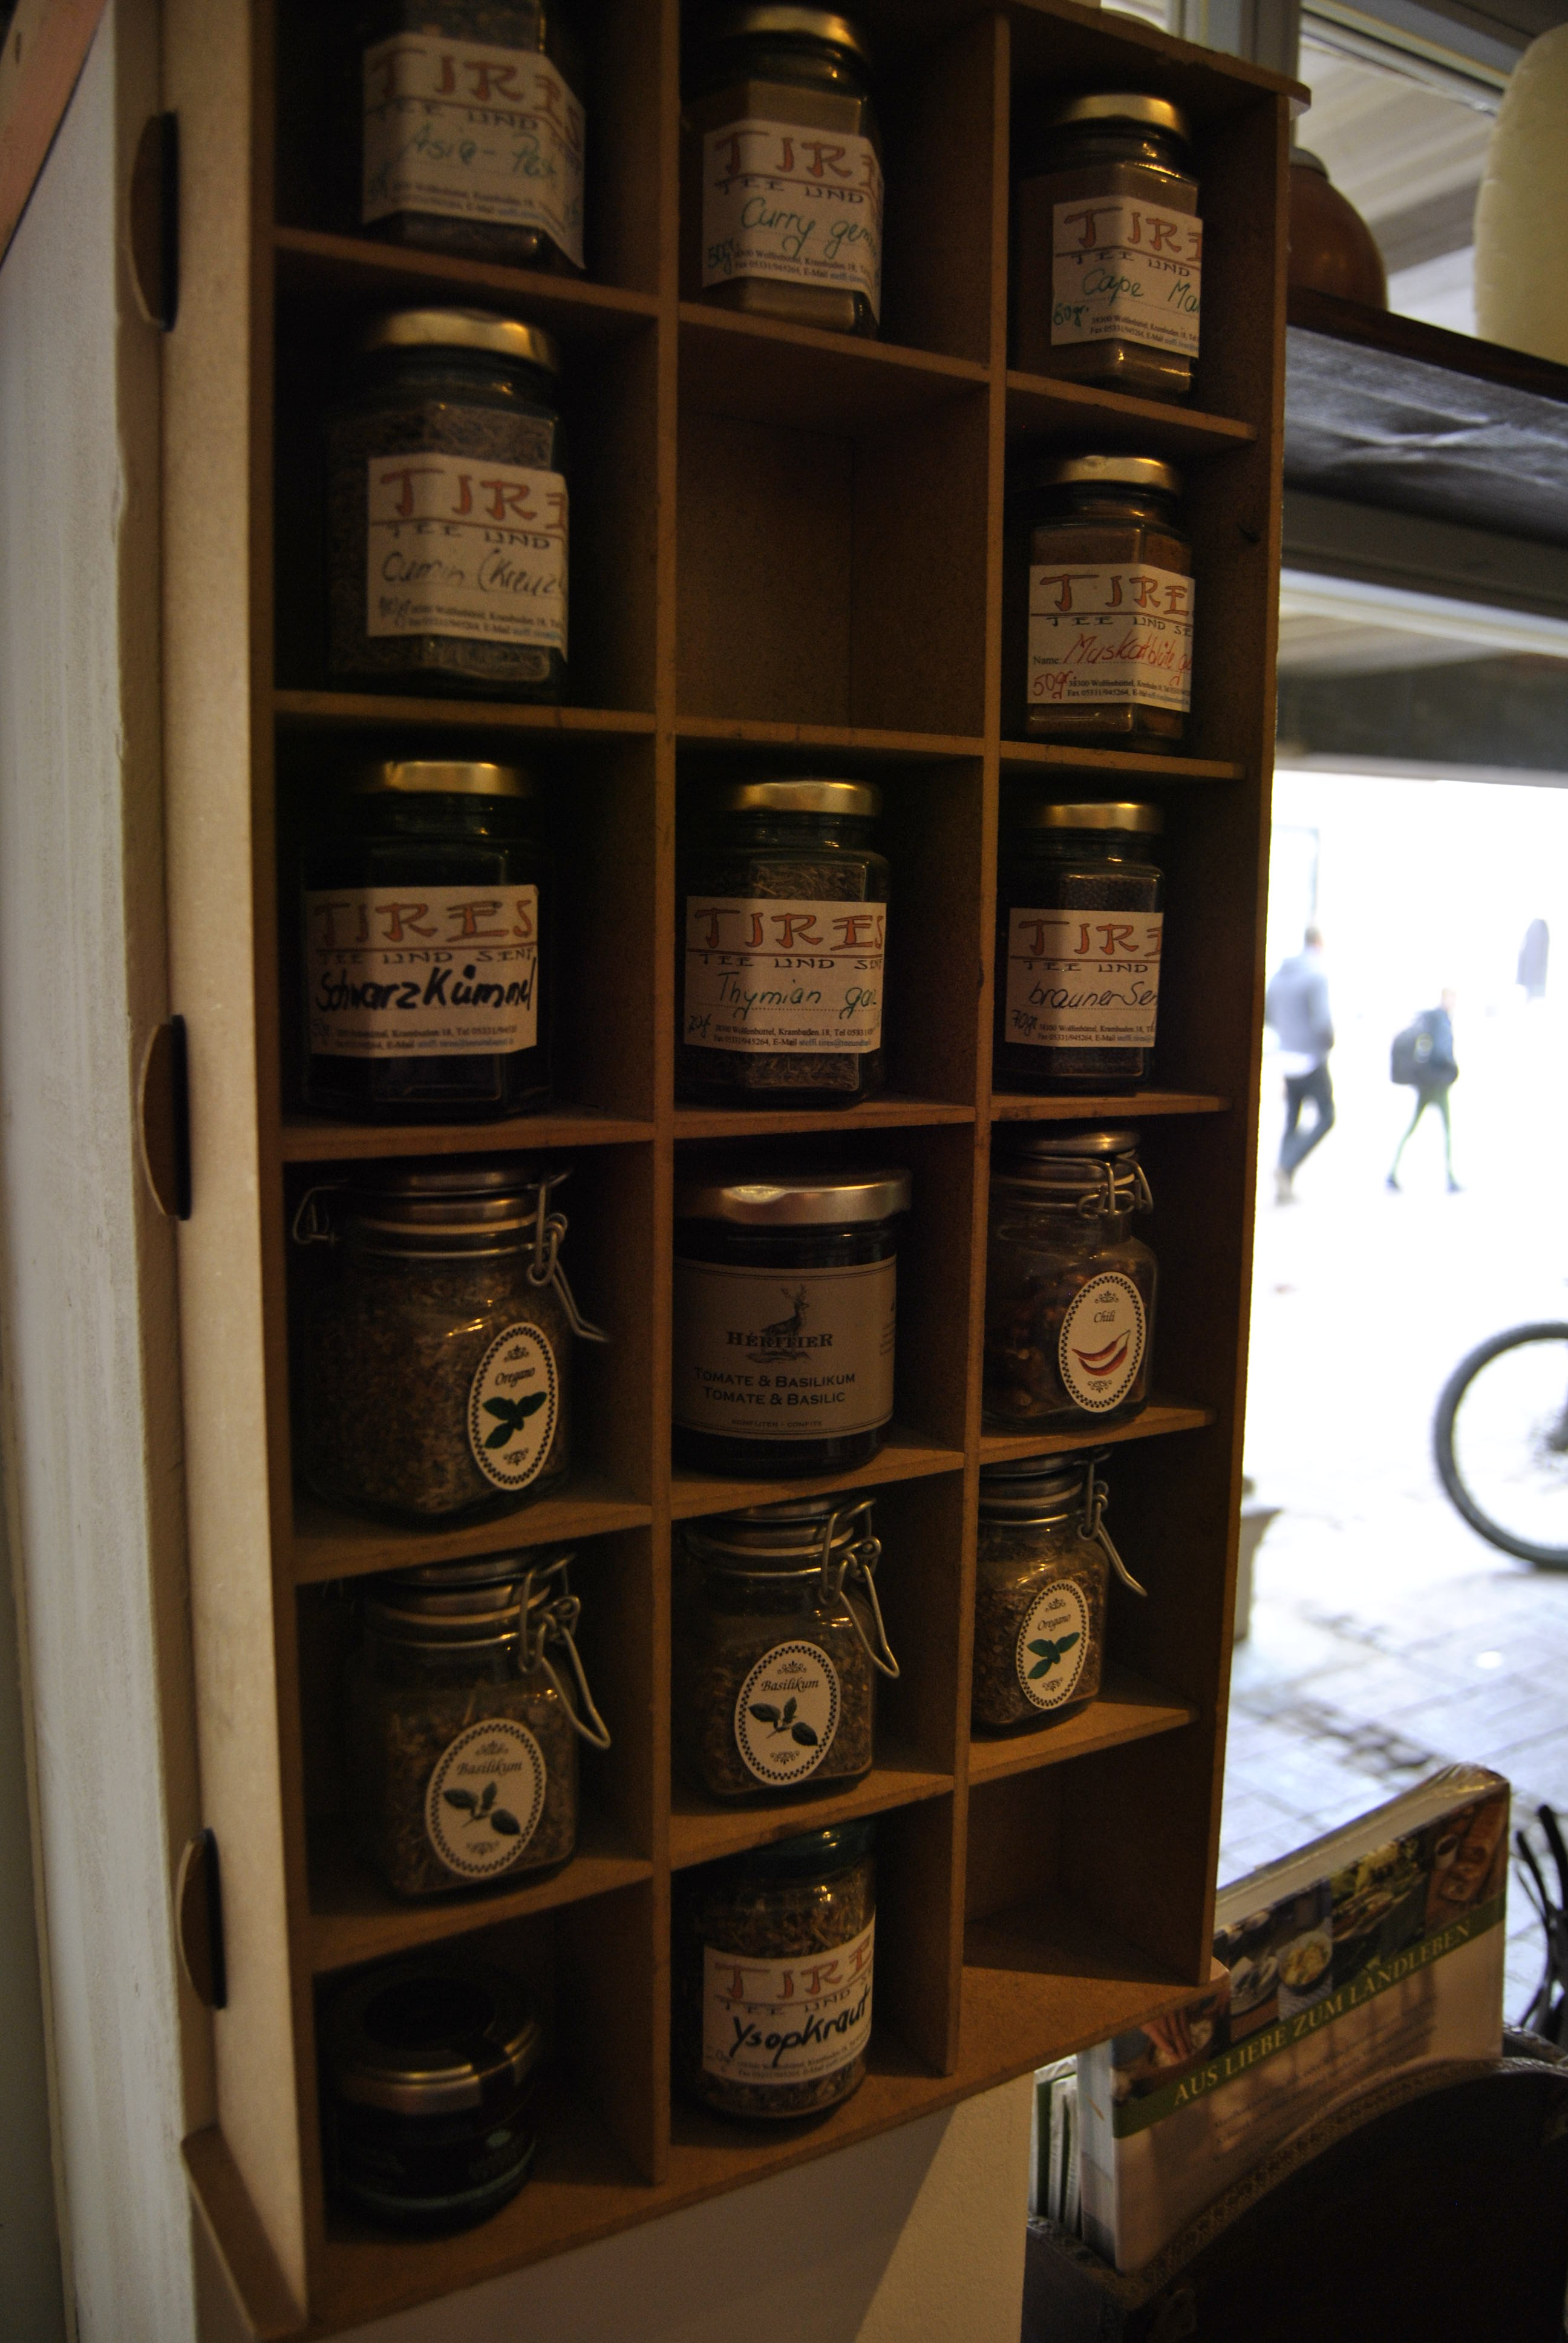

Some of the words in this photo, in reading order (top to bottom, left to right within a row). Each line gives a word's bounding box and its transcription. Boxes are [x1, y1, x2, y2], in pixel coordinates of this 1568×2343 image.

[805, 186, 864, 204] UND
[740, 197, 816, 259] Curry
[1082, 268, 1144, 307] Cape
[485, 531, 551, 551] UND
[1133, 616, 1166, 631] UND
[383, 951, 454, 965] UND
[697, 954, 754, 967] TEE
[774, 958, 835, 969] UND
[1098, 963, 1149, 973] UND
[717, 971, 822, 1021] Thymian
[1093, 1309, 1116, 1323] Chili
[758, 1374, 771, 1388] &
[775, 1373, 856, 1388] BASILIKUM
[702, 1386, 766, 1405] TOMATE
[769, 1392, 783, 1406] &
[787, 1392, 846, 1406] BASILIC
[760, 1676, 820, 1693] Basilikum
[457, 1758, 523, 1776] Basilikum
[1174, 2069, 1220, 2106] AUS
[1225, 2026, 1288, 2076] LIEBE
[1292, 1995, 1344, 2038] ZUM
[1349, 1919, 1472, 2004] LANDLEBEN
